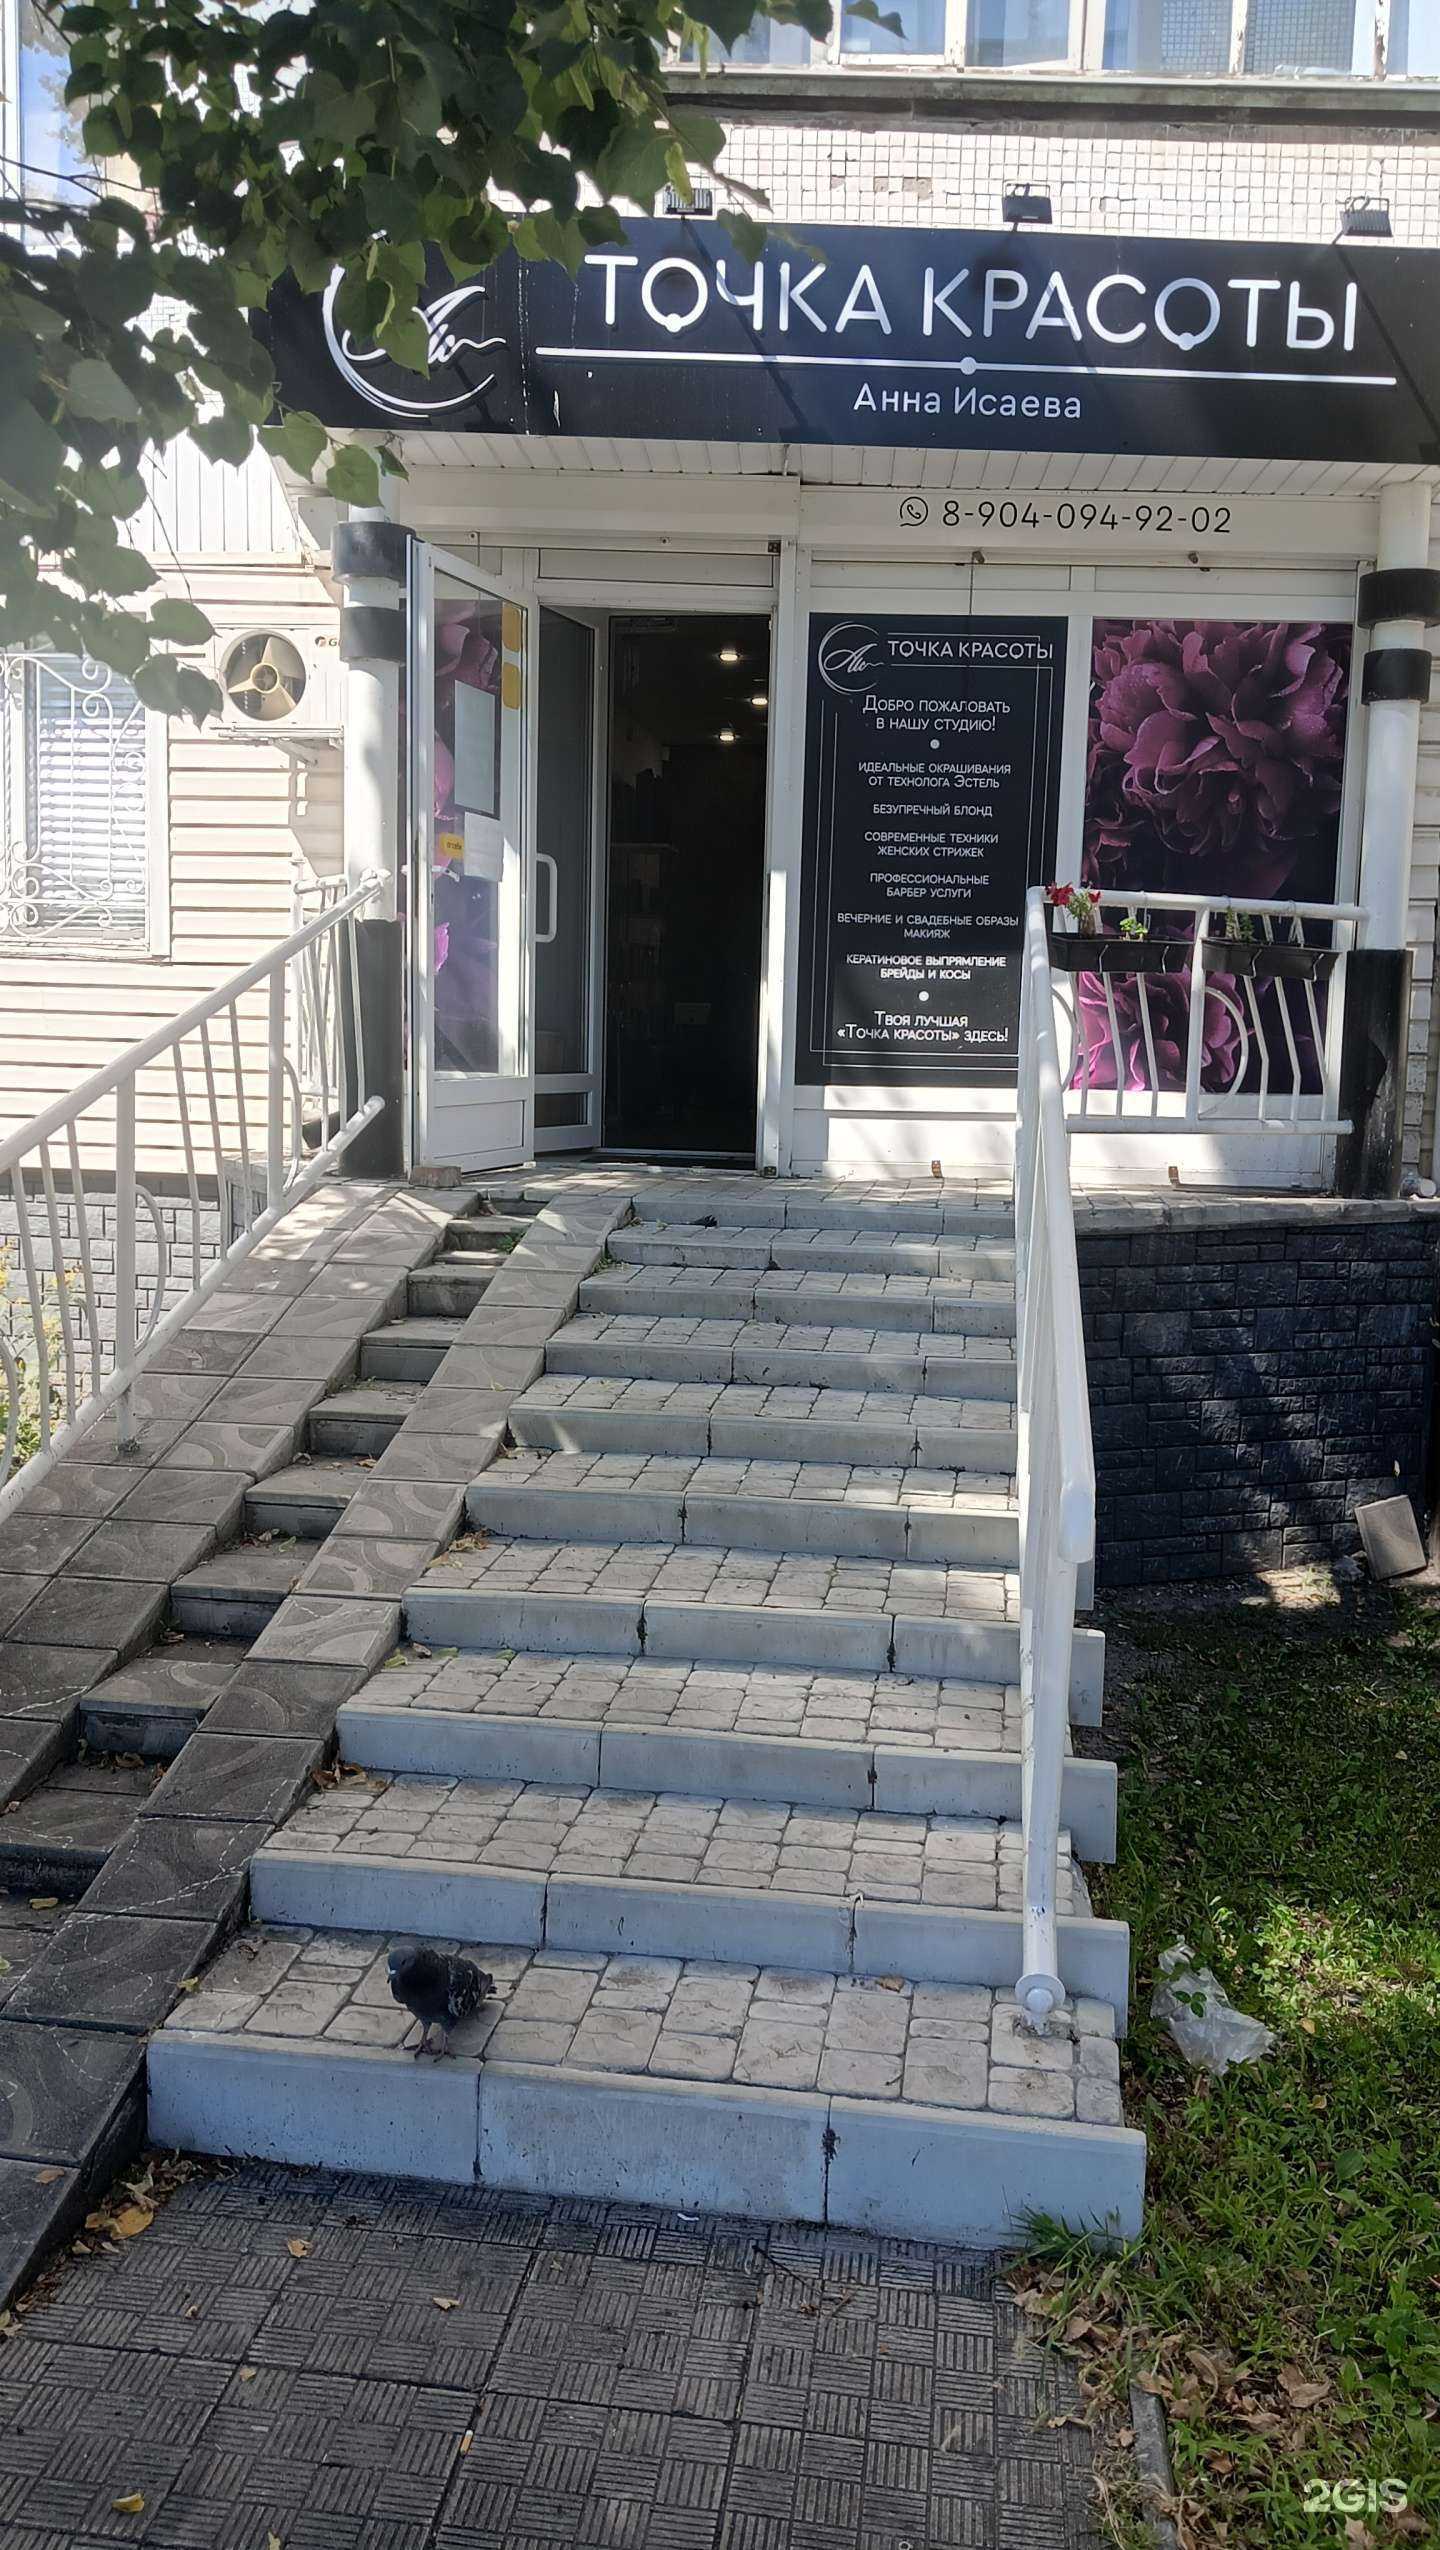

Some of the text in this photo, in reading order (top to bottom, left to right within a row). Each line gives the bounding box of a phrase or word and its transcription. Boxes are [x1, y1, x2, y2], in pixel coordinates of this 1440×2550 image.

[584, 252, 894, 337] ТОЧКА
[922, 267, 1358, 352] КРАСОТЫ
[853, 383, 1082, 420] Анна Исаева
[942, 501, 1231, 533] 8-904-094-92-02
[888, 640, 953, 658] ТОЧКА
[959, 642, 1053, 660] КРАСОТЫ
[919, 700, 1010, 713] ПОЖАЛОВАТЬ
[876, 716, 996, 733] В НАШУ СТУДИЮ!
[858, 762, 1011, 774] ИДЕАЛЬНЫЕ ОКРАШИВАНИЯ
[869, 776, 883, 787] ОТ
[887, 776, 950, 787] ТЕХНОЛОГА
[873, 803, 992, 817] БЕЗУПРЕЧНЫЙ БЛОНД
[865, 832, 999, 843] СОВРЕМЕННЫЕ ТЕХНИКИ
[877, 846, 984, 857] ЖЕНСКИХ СТРИЖЕК
[870, 873, 989, 885] ПРОФЕССИОНАЛЬНЫЕ
[887, 887, 972, 898] БАРБЕР УСЛУГИ
[837, 913, 1018, 926] ВЕЧЕРНИЕ И СВАДЕБНЫЕ ОБРАЗЫ
[904, 929, 950, 939] МАКИЯЖ
[847, 955, 1006, 967] КЕРАТИНОВОЕ ВЫПРЯМЛЕНИЕ
[880, 967, 971, 980] БРЕЙДЫ И КОСЫ
[914, 1015, 968, 1027] ЛУЧШАЯ
[963, 1027, 1008, 1043] ЗДЕСЬ!
